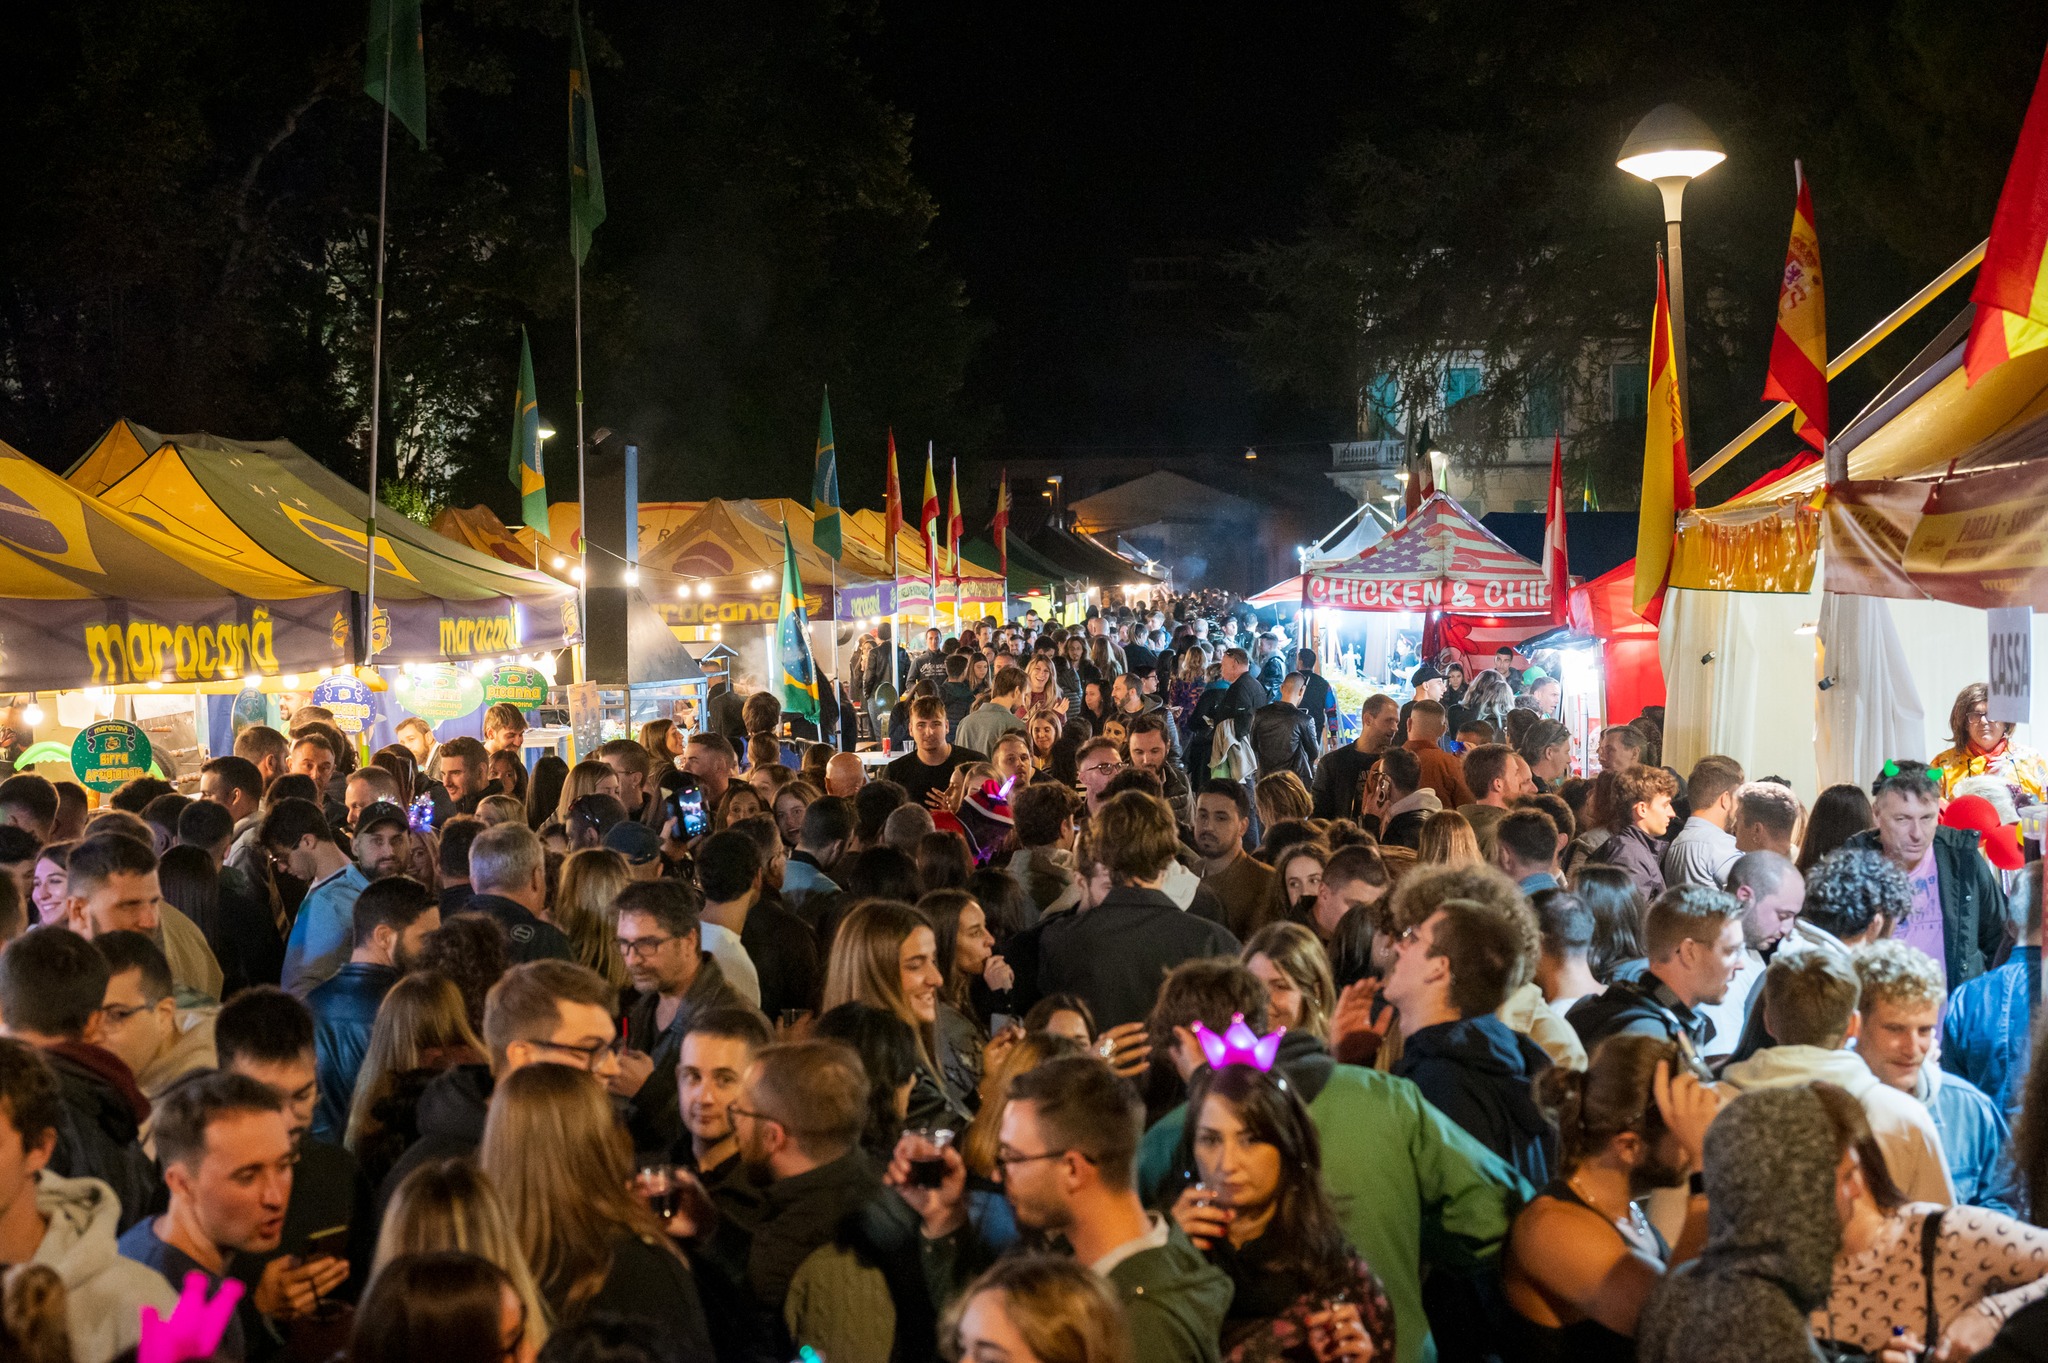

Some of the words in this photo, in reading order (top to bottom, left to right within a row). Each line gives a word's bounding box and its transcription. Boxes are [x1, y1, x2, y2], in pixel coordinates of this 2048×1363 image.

[1307, 576, 1443, 607] CHICKEN
[1452, 580, 1476, 607] &
[652, 594, 780, 623] racanã
[85, 606, 279, 684] maracanã
[1991, 633, 2030, 697] CASSA
[486, 686, 541, 700] picanha
